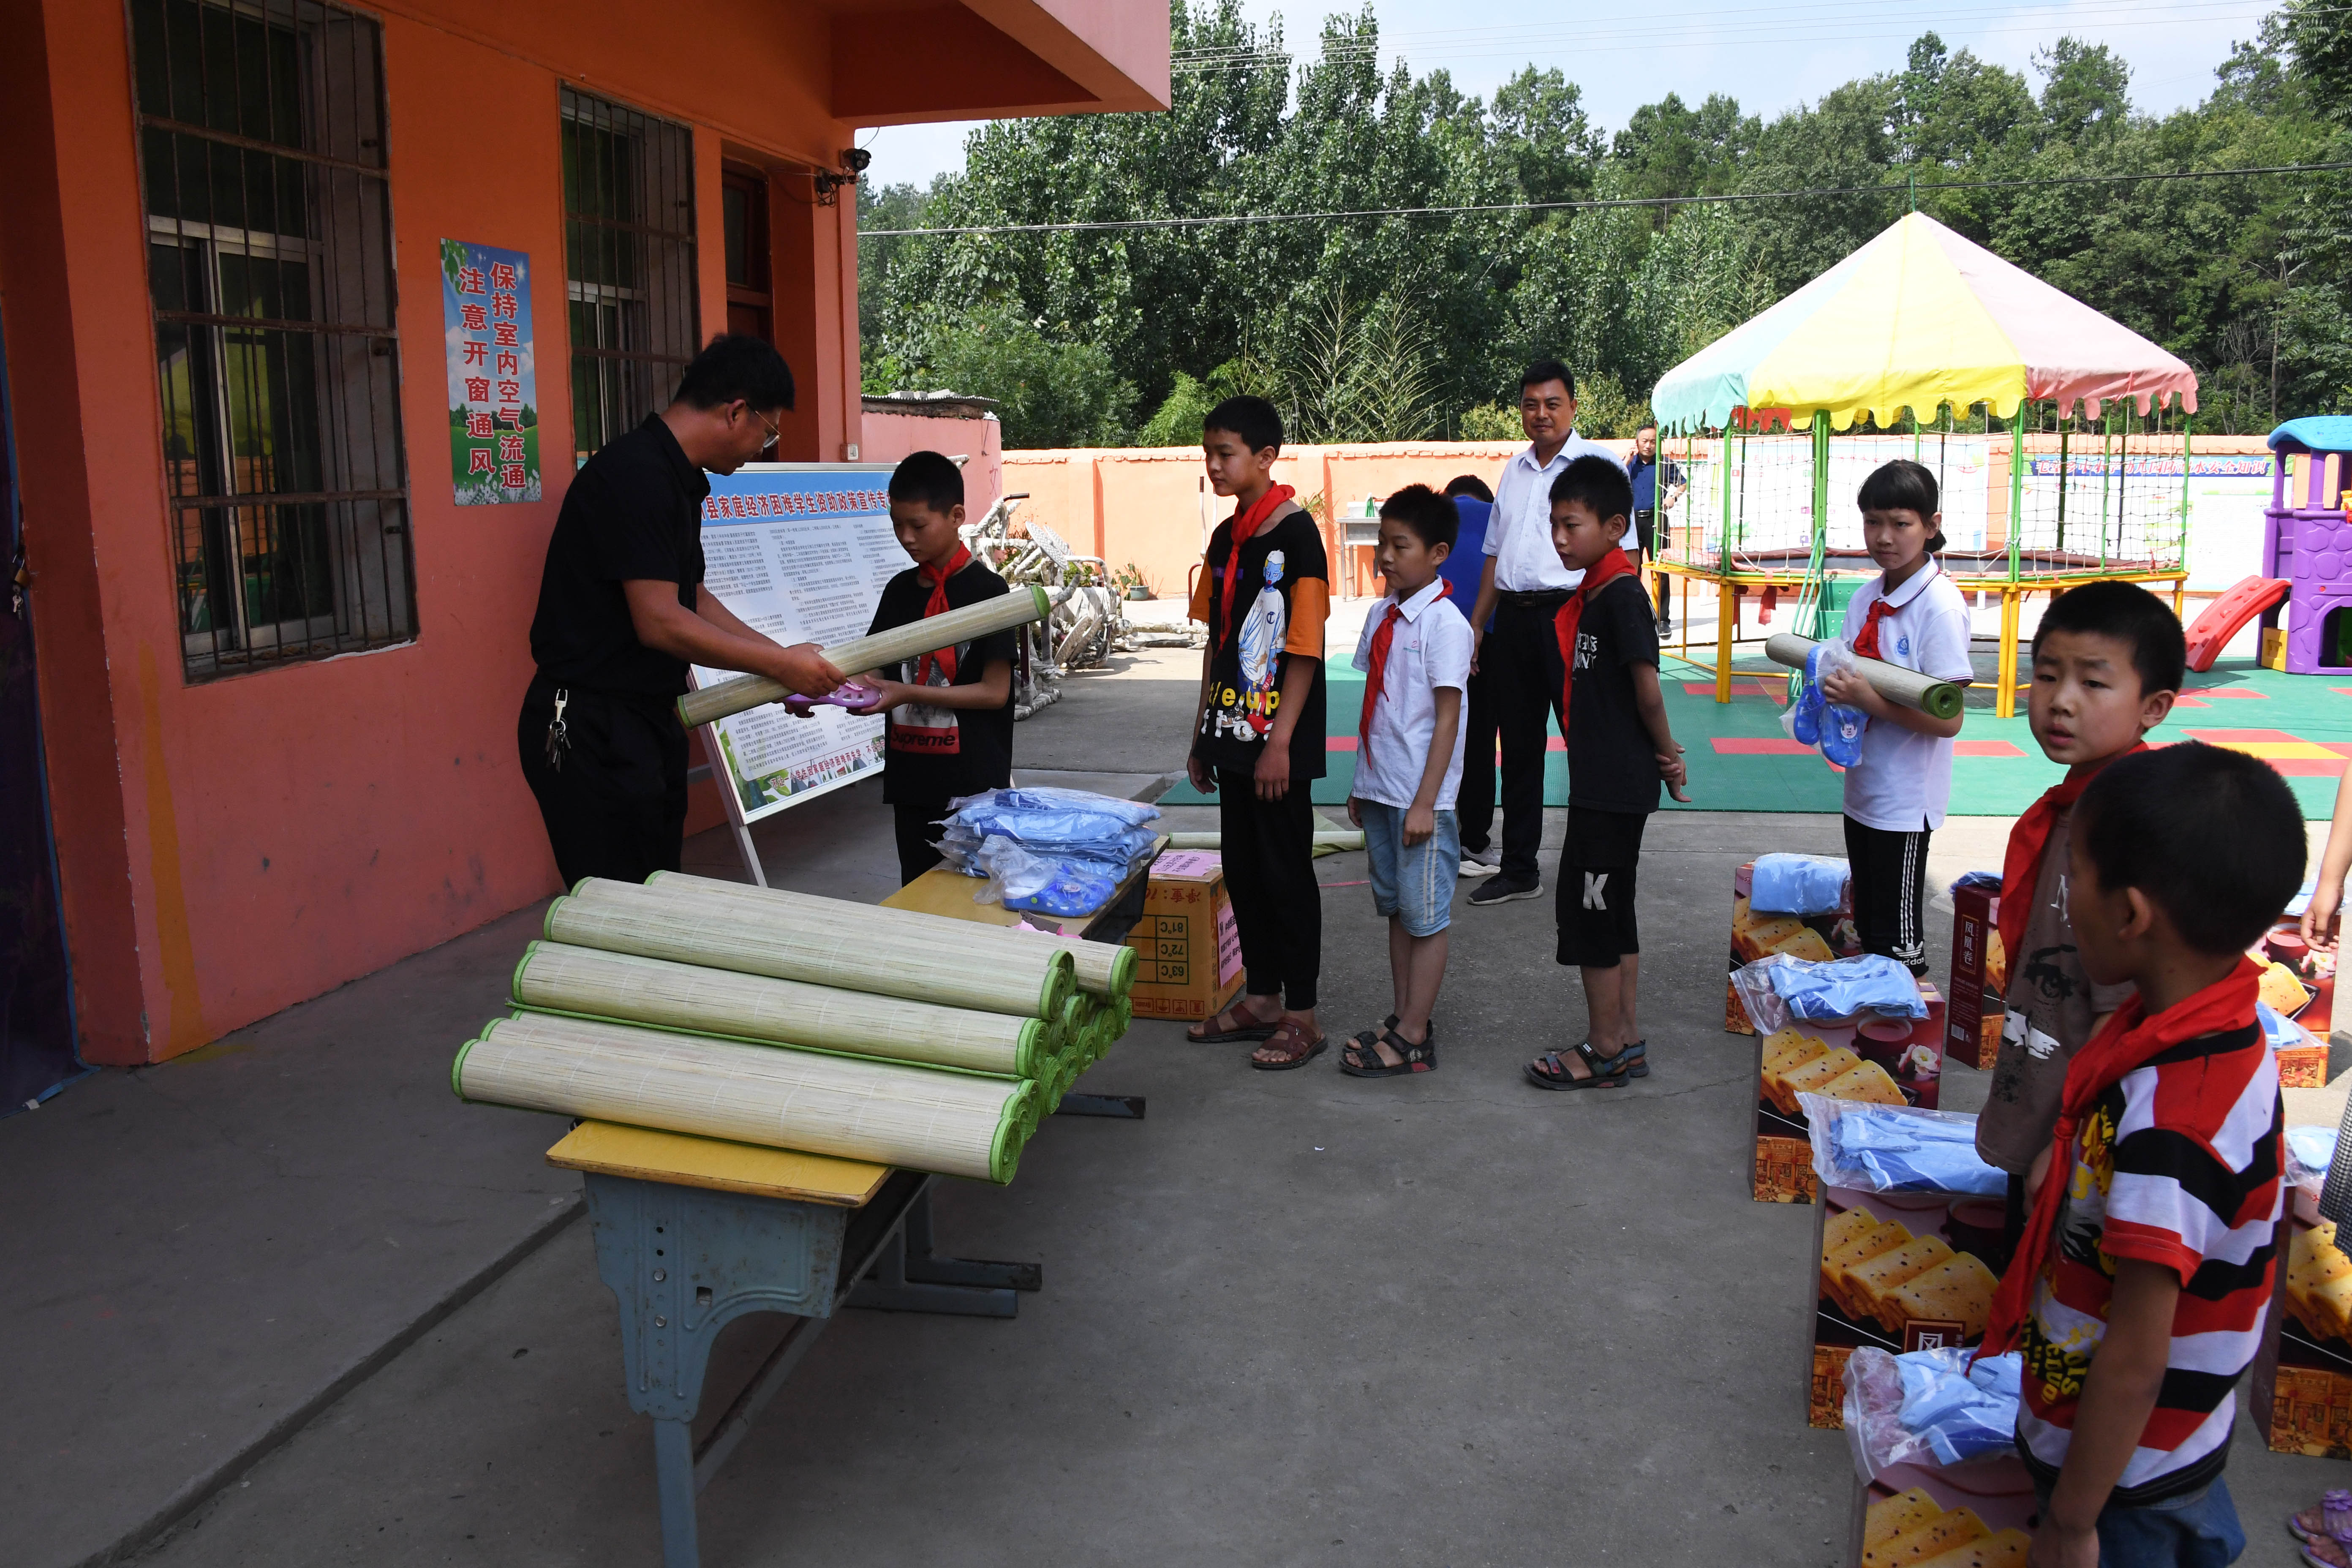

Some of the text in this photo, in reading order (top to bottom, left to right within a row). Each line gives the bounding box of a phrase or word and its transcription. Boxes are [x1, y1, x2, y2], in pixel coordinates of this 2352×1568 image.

[457, 267, 497, 476] 注意开窗通风
[489, 261, 526, 490] 保持室内空气流通
[701, 490, 890, 520] 县家庭经济困难学生资助政策宣传专
[892, 727, 956, 749] Supreme
[1582, 871, 1609, 911] K
[1160, 922, 1183, 934] 81°C
[1963, 920, 1974, 966] 凤凰卷
[1160, 944, 1184, 958] 72°C
[1161, 965, 1184, 979] 63°C
